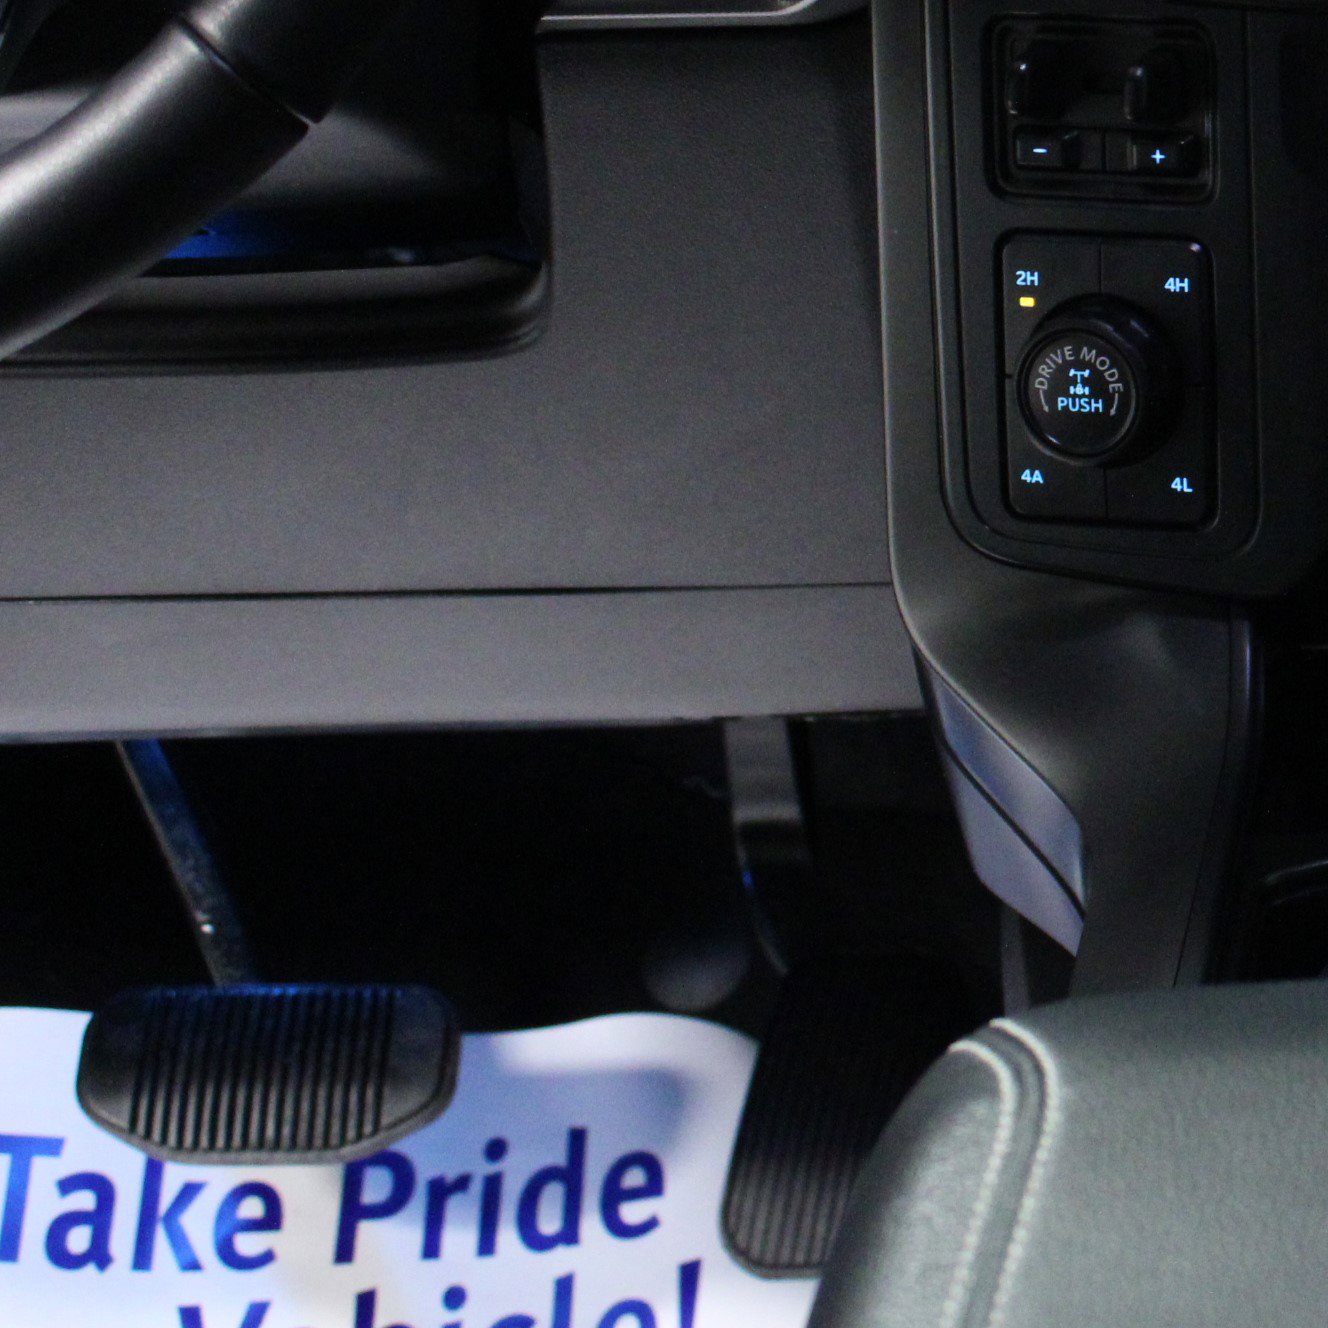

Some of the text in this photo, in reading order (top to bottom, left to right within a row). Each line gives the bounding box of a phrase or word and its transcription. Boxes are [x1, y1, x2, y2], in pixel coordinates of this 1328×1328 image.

[1016, 271, 1039, 286] 2H
[1164, 277, 1189, 293] 4H
[1034, 345, 1123, 393] DRIVE MODE
[1057, 397, 1103, 412] PUSH
[1021, 469, 1044, 484] 4A
[1171, 478, 1193, 493] 4L
[0, 1126, 665, 1273] Take Pride
